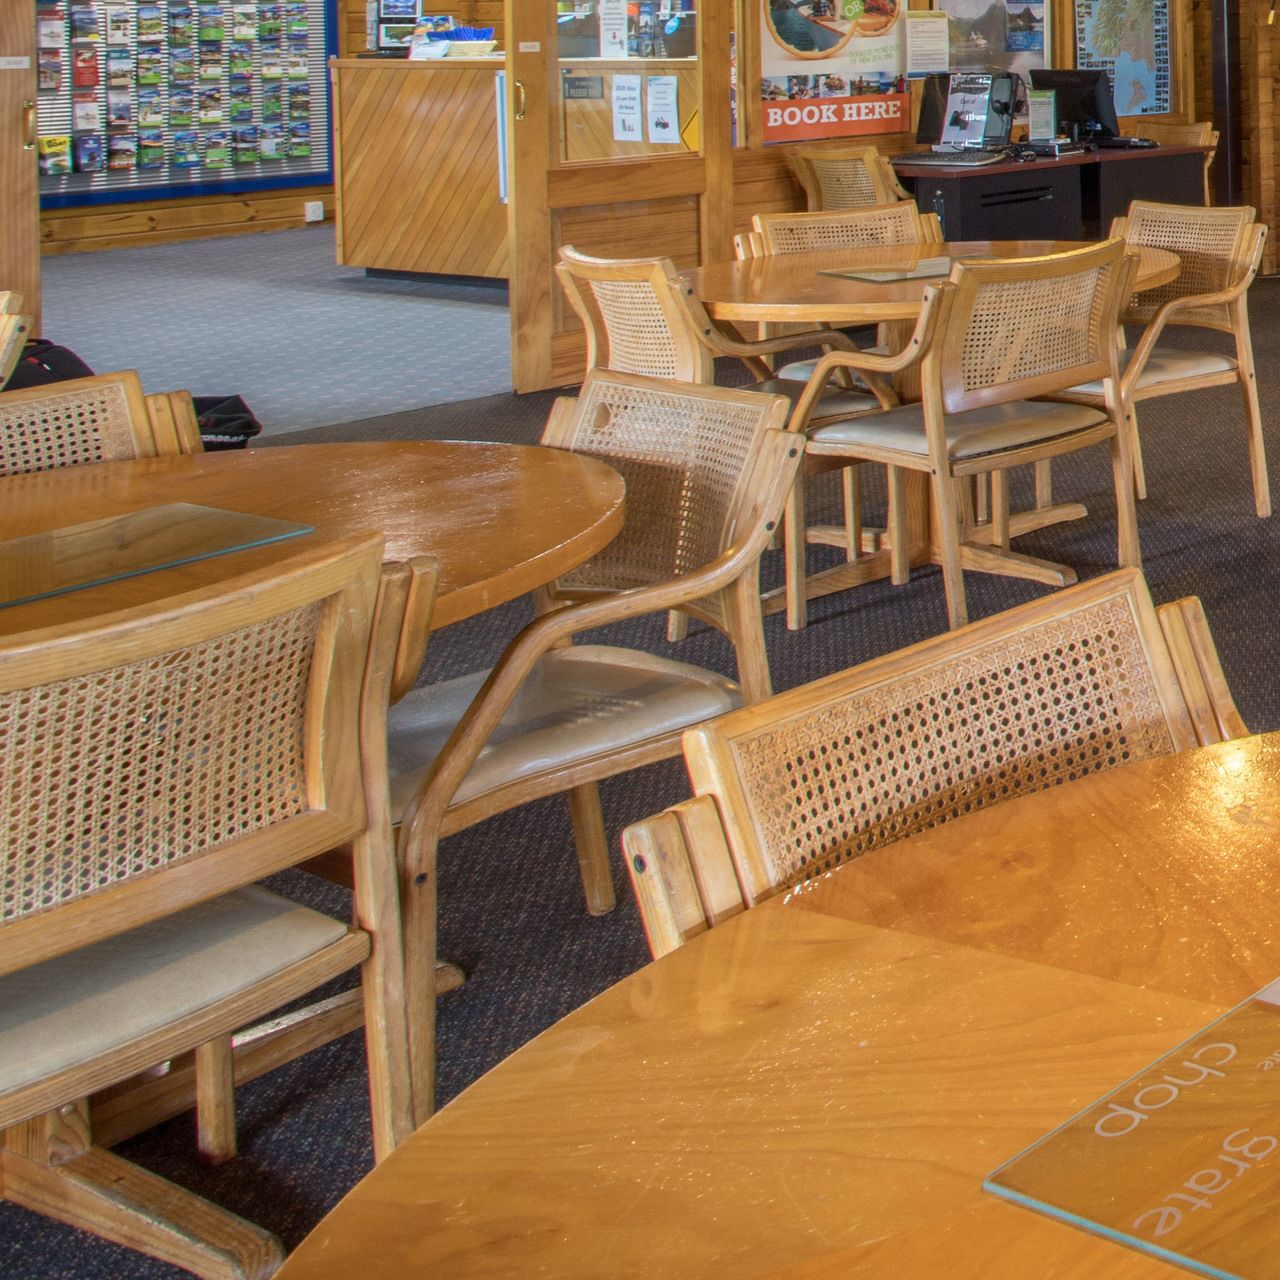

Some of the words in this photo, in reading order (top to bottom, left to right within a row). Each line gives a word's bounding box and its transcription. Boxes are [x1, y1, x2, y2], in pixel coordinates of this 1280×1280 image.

[844, 0, 864, 17] OR
[767, 104, 838, 127] BOOK
[843, 100, 901, 122] HERE
[1094, 1042, 1237, 1137] chop
[1132, 1127, 1278, 1238] grate
